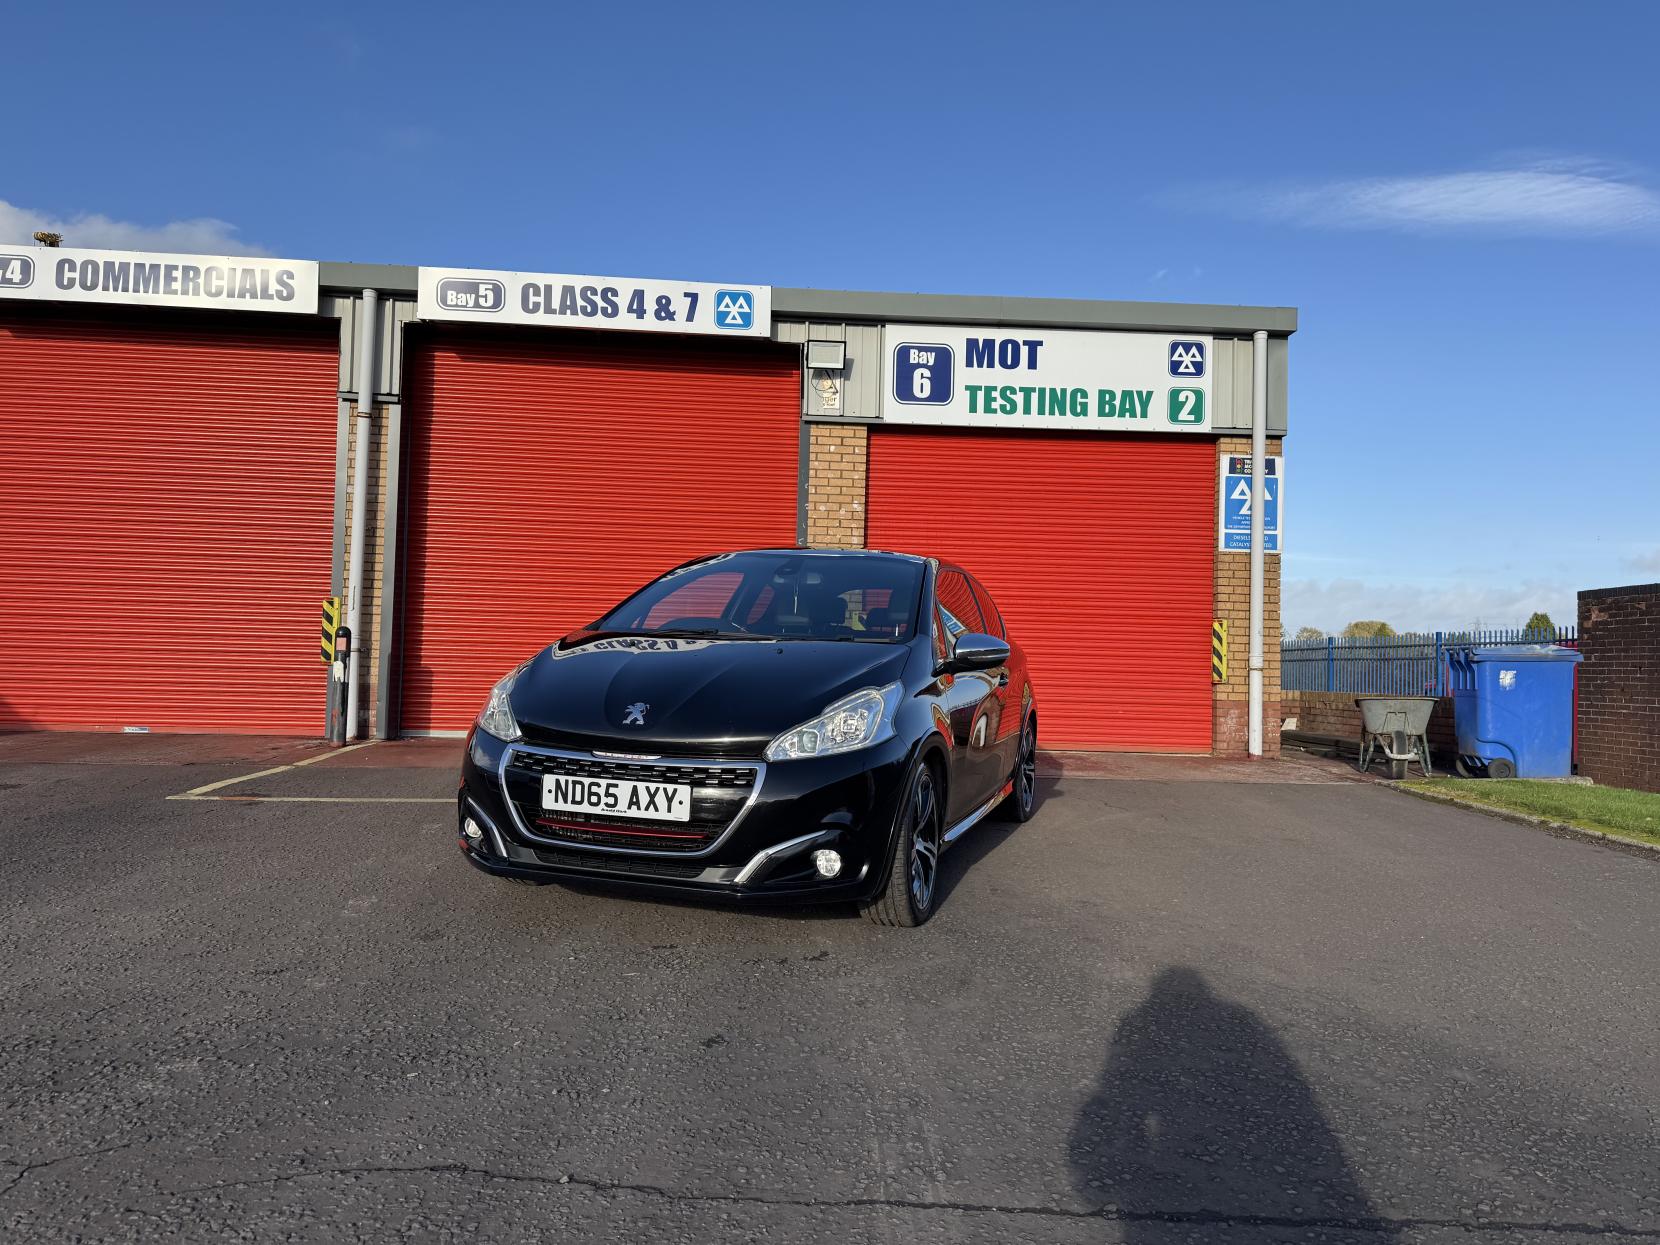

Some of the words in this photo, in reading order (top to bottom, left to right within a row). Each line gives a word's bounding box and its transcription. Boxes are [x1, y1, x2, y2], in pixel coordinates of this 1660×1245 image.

[5, 259, 22, 283] 4
[55, 257, 295, 302] COMMERCIALS
[446, 290, 475, 308] Bay
[478, 283, 494, 307] 5
[520, 282, 619, 319] CLASS
[626, 288, 647, 320] 4
[654, 294, 676, 322] &
[683, 291, 699, 323] 7
[909, 348, 935, 367] Bay
[964, 337, 1044, 370] MOT
[912, 368, 932, 399] 6
[964, 384, 1089, 418] TESTING
[1097, 389, 1154, 419] BAY
[1178, 390, 1196, 421] 2
[554, 778, 619, 809] ND65
[627, 784, 678, 814] AXY
